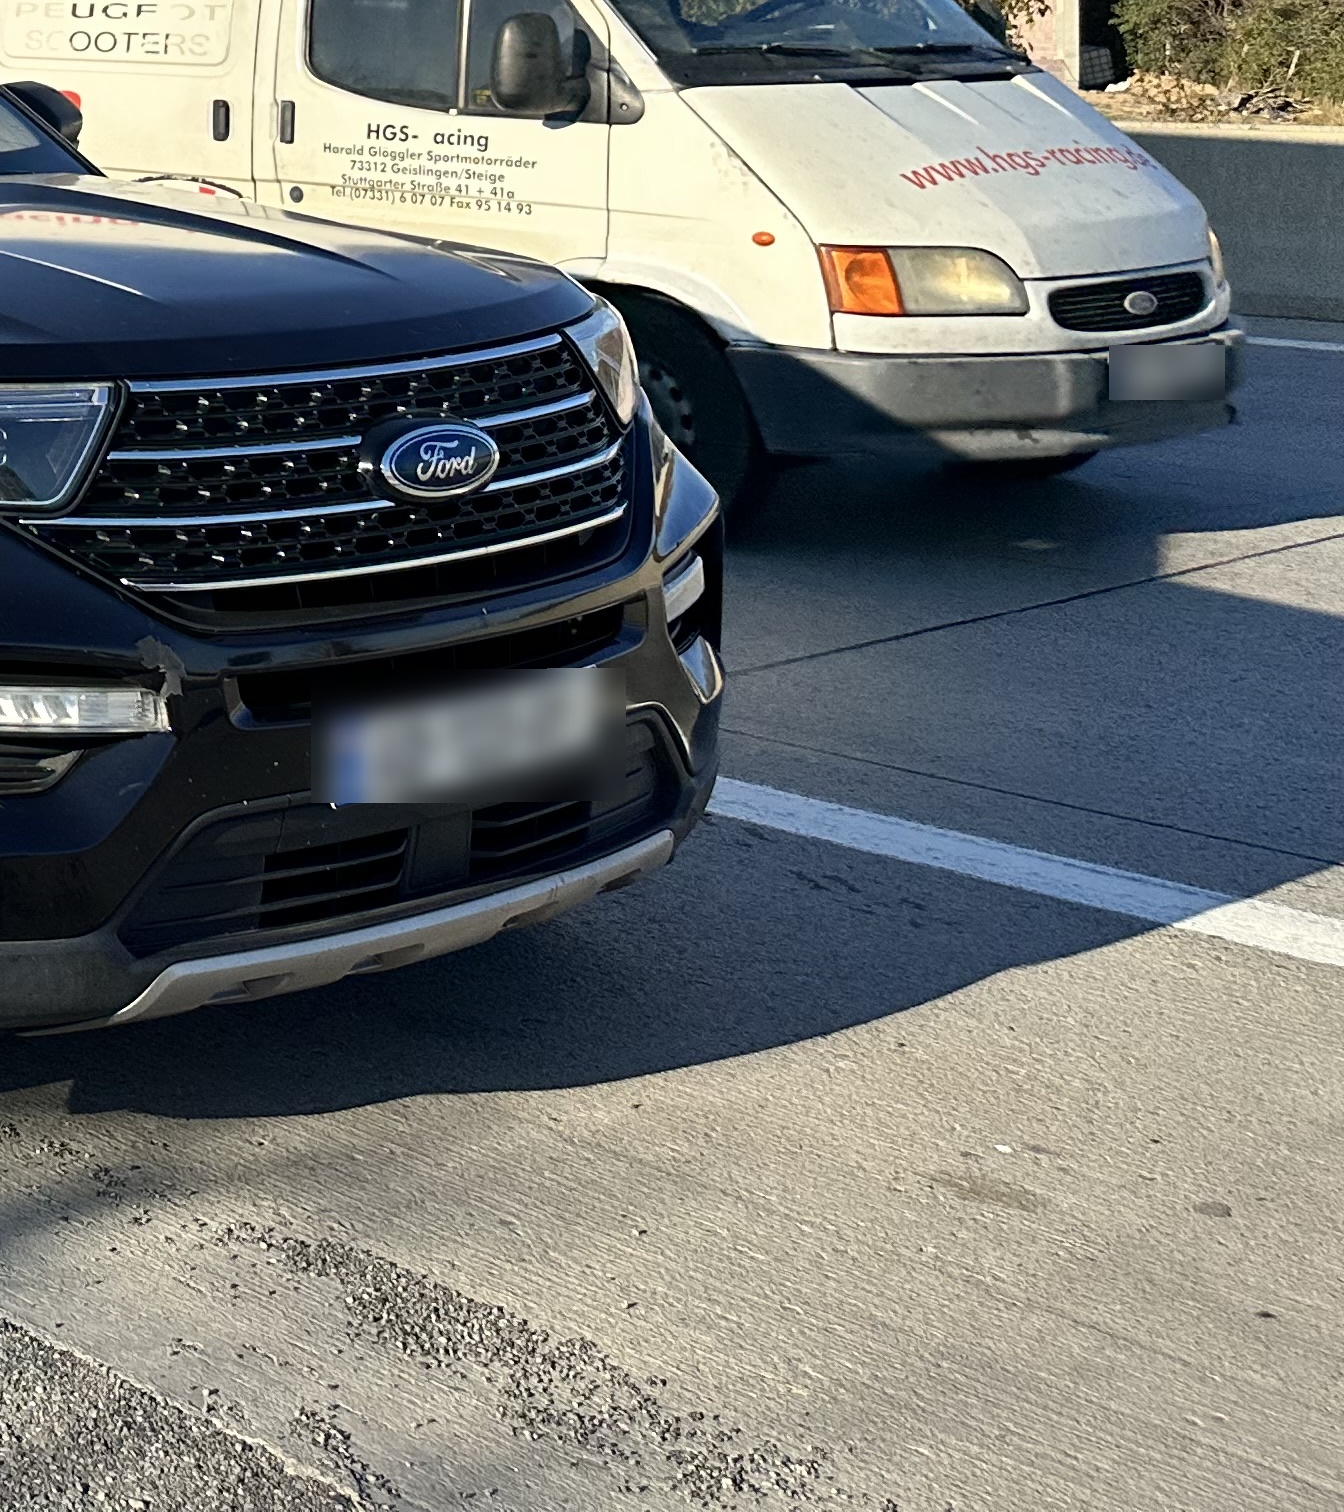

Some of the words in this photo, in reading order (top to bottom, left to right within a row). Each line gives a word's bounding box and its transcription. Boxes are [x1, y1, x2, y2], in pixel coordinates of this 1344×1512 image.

[323, 143, 364, 156] Harald
[426, 150, 538, 169] Sportmotorräder
[350, 160, 387, 172] 73312
[341, 173, 406, 190] Stuttgarter
[410, 180, 451, 195] Straße
[455, 183, 469, 195] 41
[490, 186, 515, 199] 41a
[411, 192, 426, 205] 07
[430, 194, 445, 207] 07
[450, 196, 472, 209] Fax
[475, 198, 491, 211] 95
[497, 200, 512, 213] 14
[516, 202, 532, 215] 93
[416, 439, 478, 482] Ford
